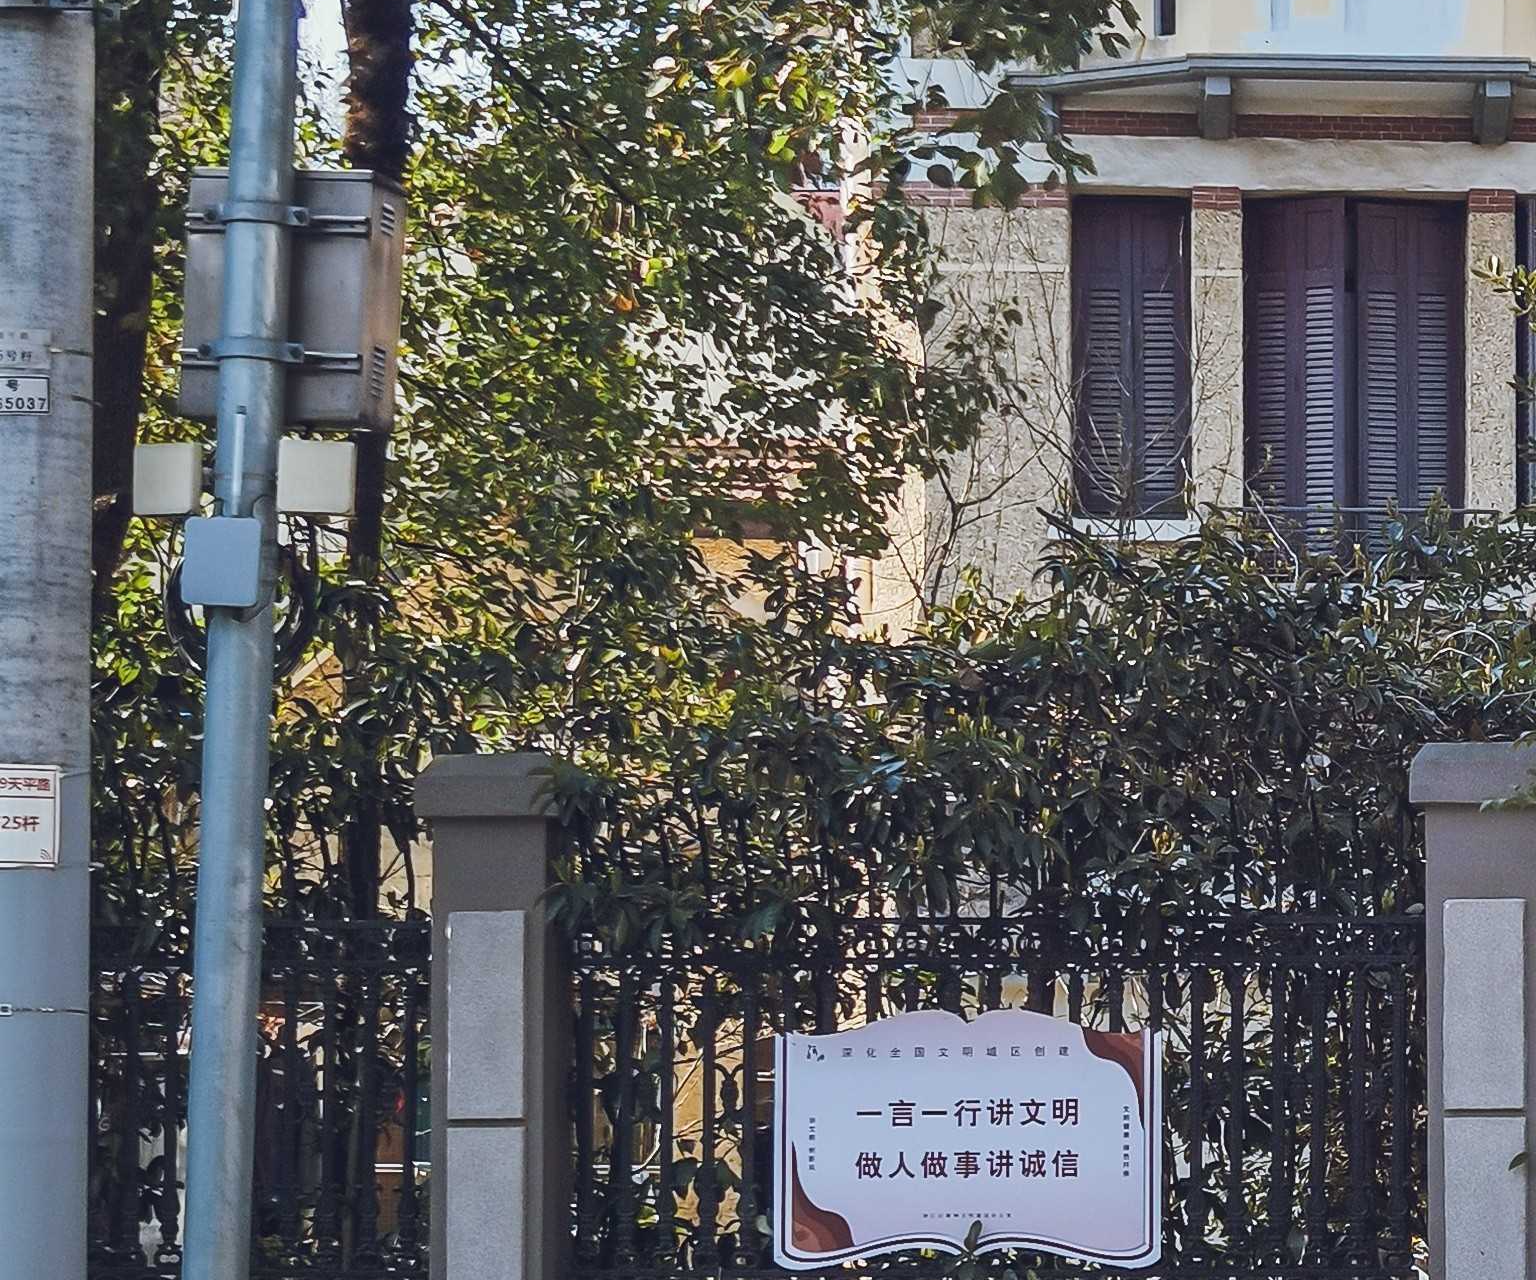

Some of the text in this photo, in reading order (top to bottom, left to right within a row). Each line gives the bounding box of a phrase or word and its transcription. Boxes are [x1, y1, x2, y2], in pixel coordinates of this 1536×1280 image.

[0, 396, 47, 410] 5037
[841, 1045, 1070, 1059] 深化全国文明城区创建
[856, 1098, 1080, 1127] 一言一行讲文明
[855, 1150, 1079, 1179] 做人做事讲诚信
